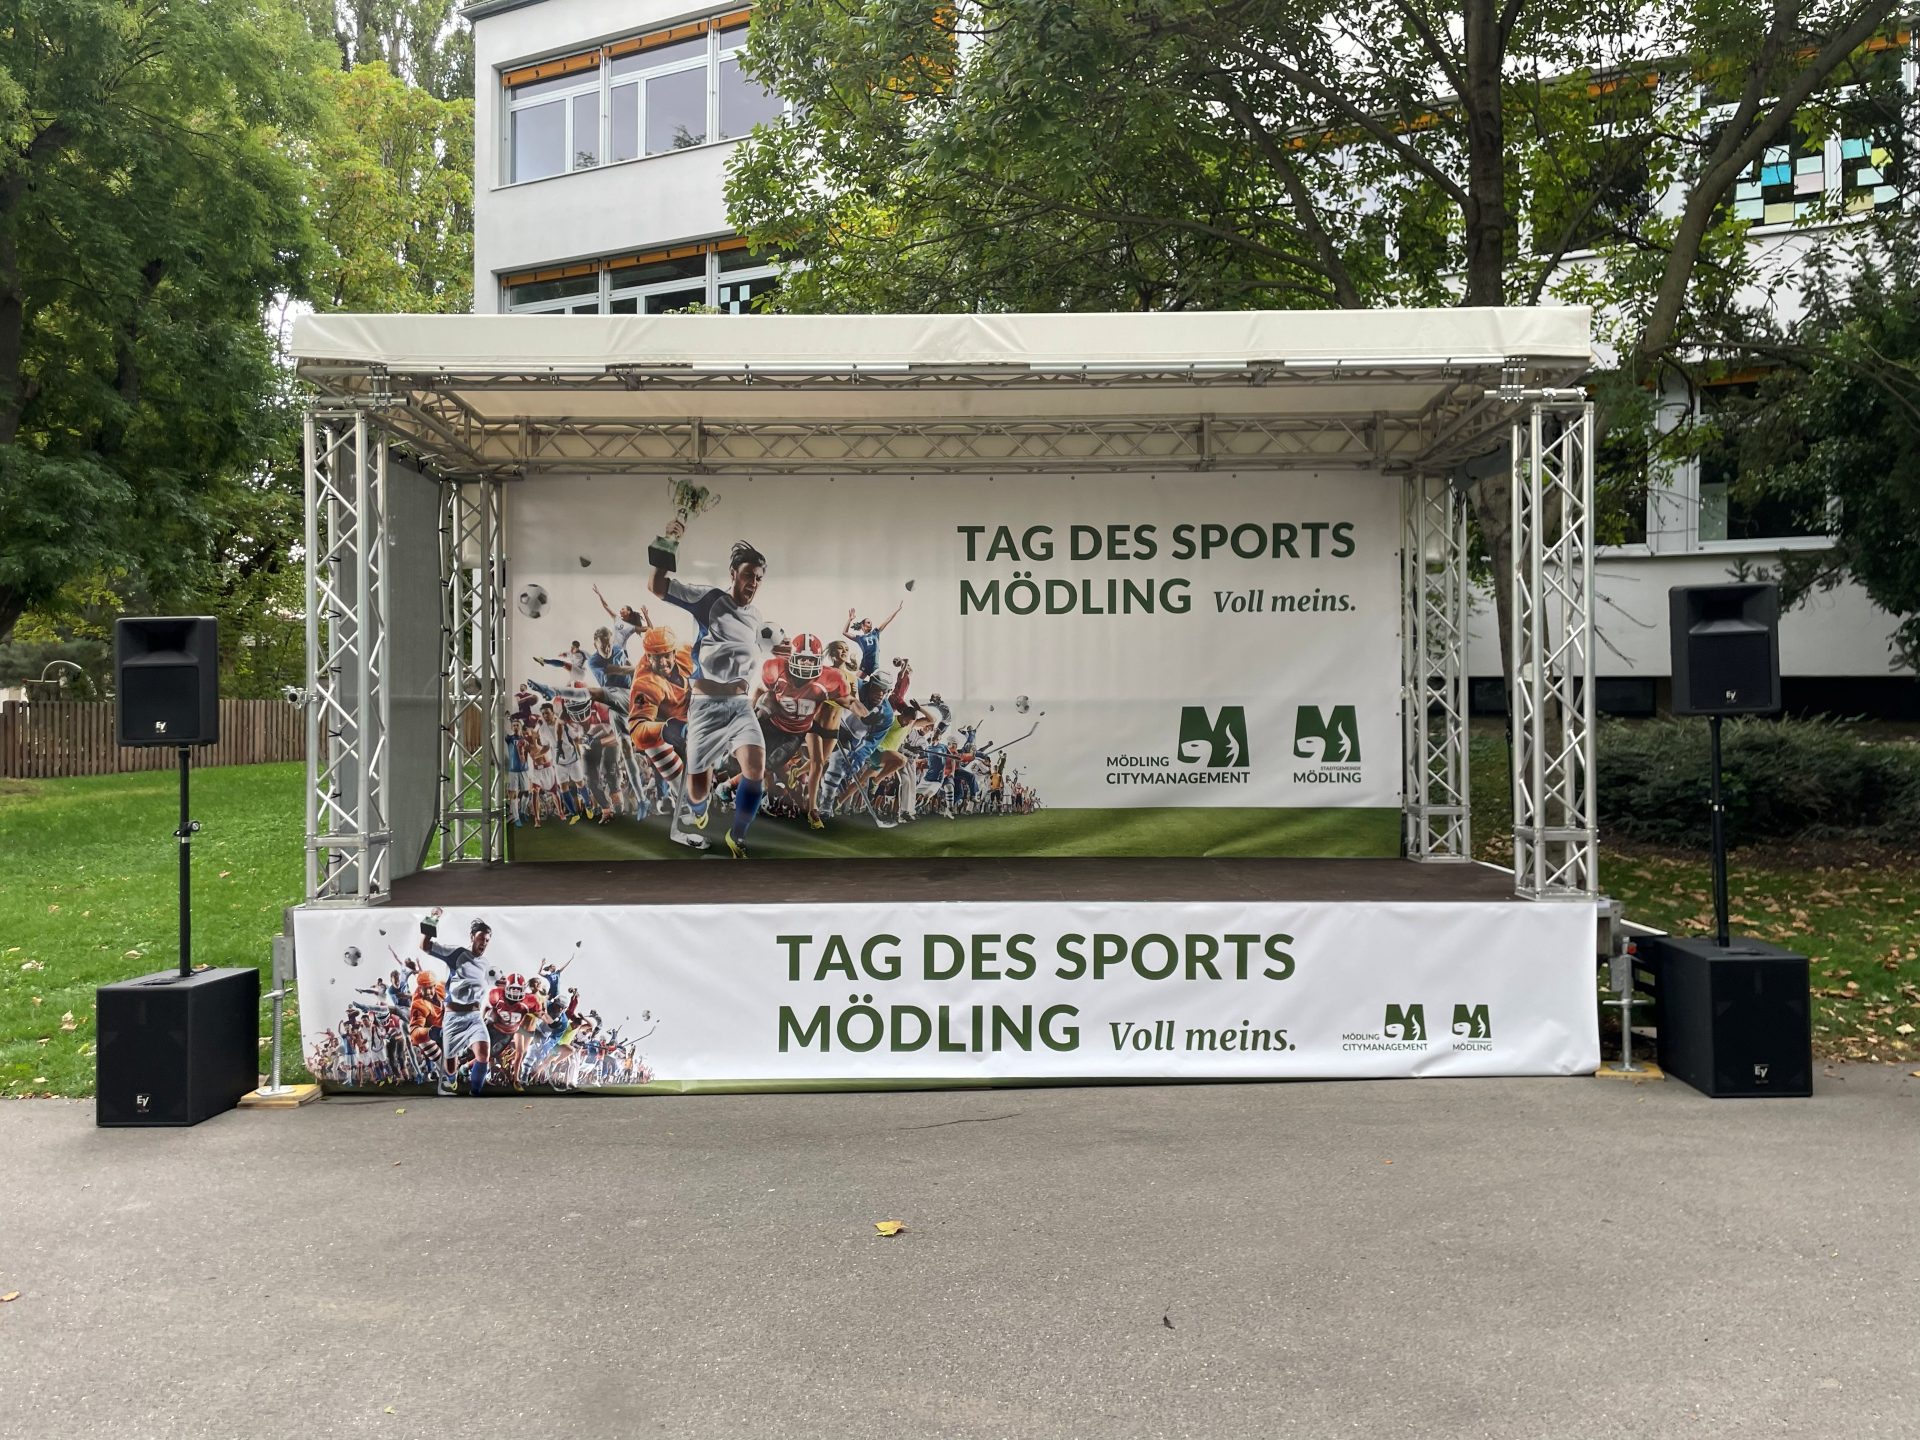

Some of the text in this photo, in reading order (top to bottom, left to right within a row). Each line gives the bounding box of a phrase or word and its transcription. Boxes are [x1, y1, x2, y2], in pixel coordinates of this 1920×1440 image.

[956, 521, 1357, 562] TAG DES SPORTS
[959, 571, 1357, 616] MÖDLING Voll meins.
[1106, 754, 1170, 767] MÖDLING
[1106, 771, 1251, 785] CITYMANAGEMENT
[1293, 769, 1362, 784] MÖDLING
[776, 933, 1296, 982] TAG DES SPORTS
[778, 993, 1297, 1053] MÖDLING Voll meins.
[1342, 1032, 1380, 1041] MÖDLING
[1342, 1043, 1428, 1052] CITYMANAGEMENT
[1452, 1042, 1493, 1052] MÖDLING
[136, 1095, 150, 1107] EV
